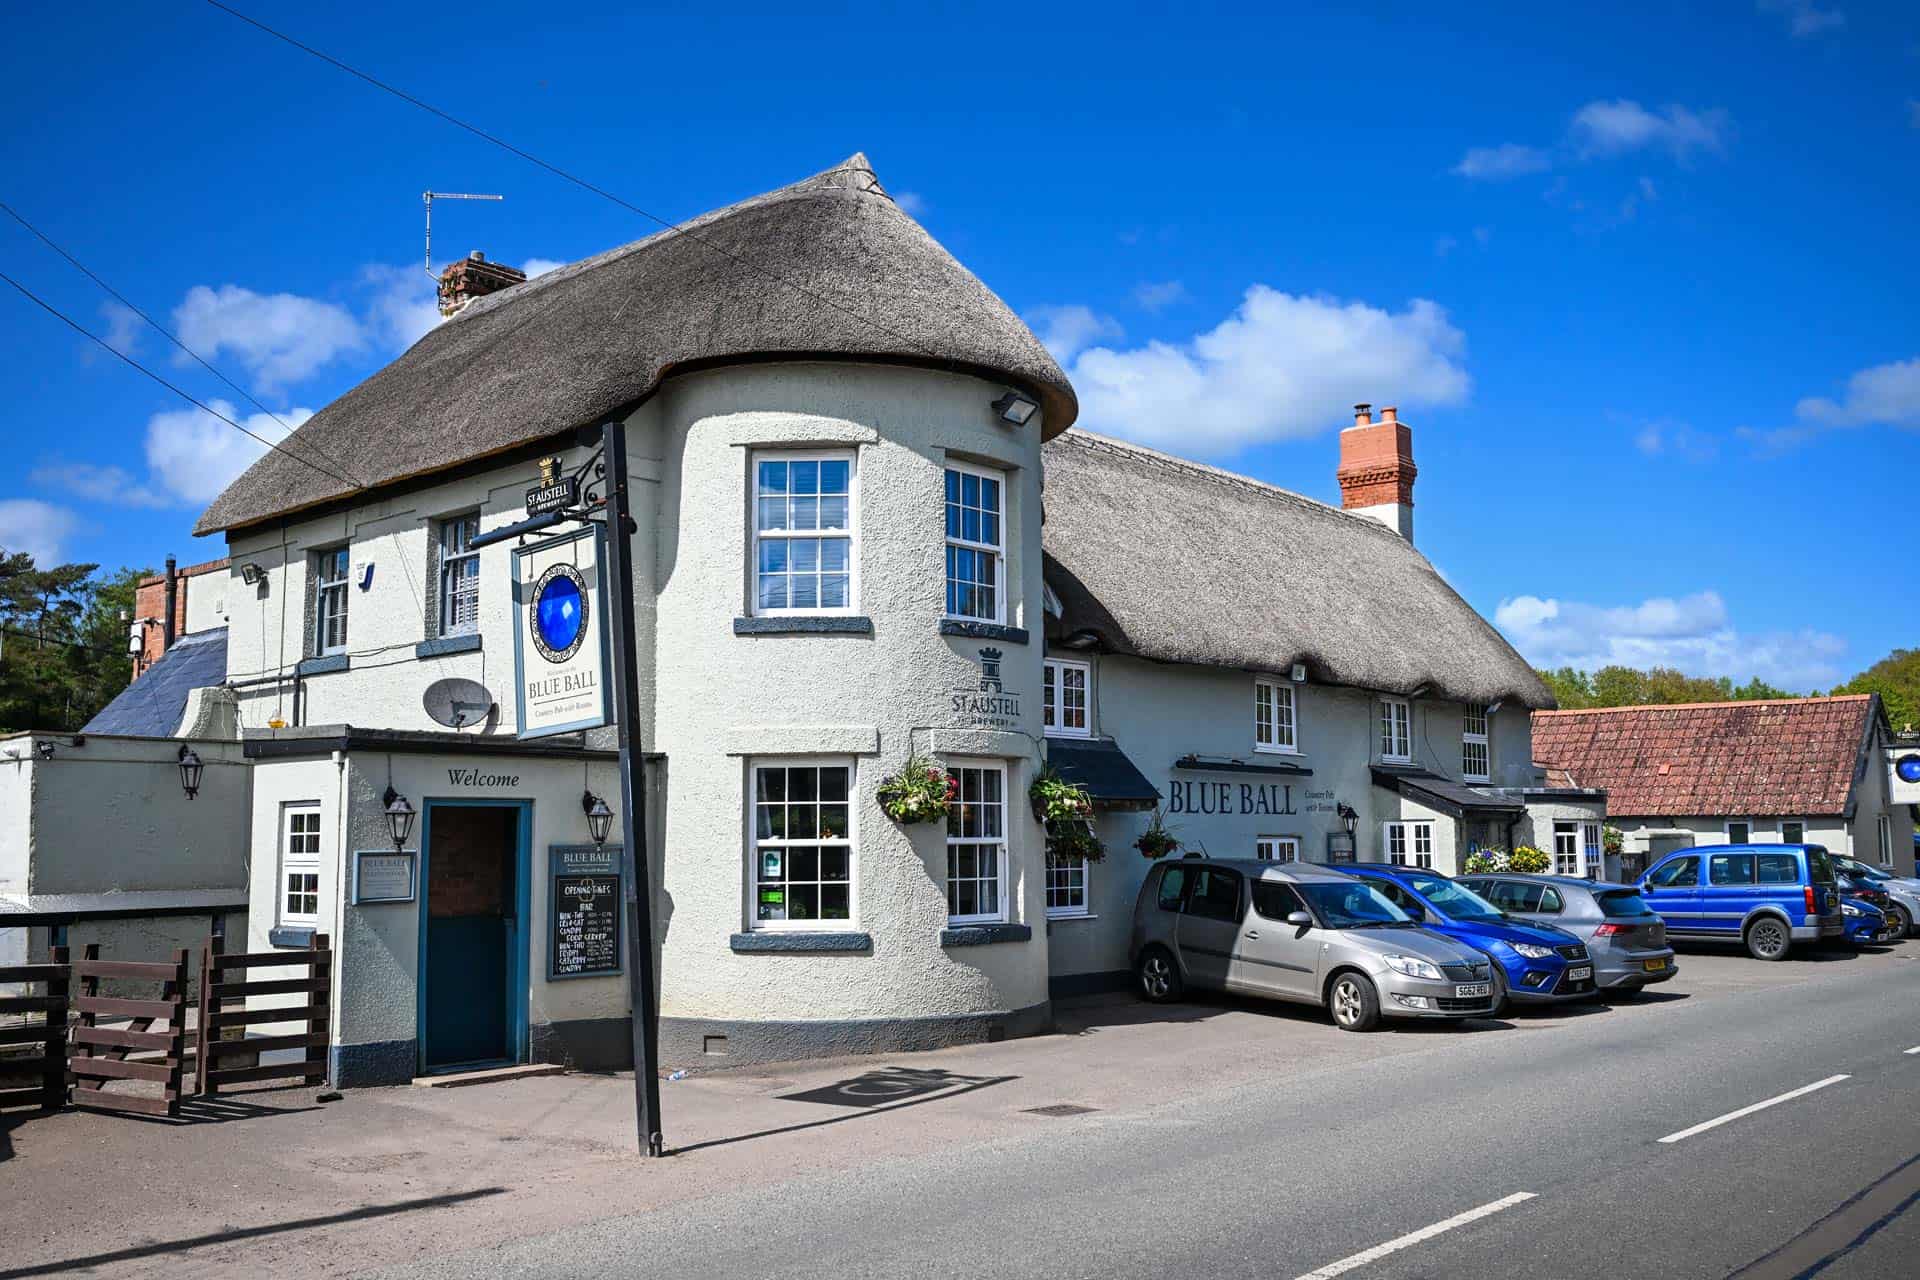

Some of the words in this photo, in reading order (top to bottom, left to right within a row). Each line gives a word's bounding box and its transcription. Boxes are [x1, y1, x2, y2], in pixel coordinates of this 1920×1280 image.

[536, 484, 568, 504] AUSTELL
[529, 678, 560, 699] BLUE
[564, 670, 598, 692] BALL
[969, 697, 1020, 716] AUSTELL
[448, 769, 519, 787] Welcome
[1169, 780, 1232, 814] BLUE
[1240, 783, 1297, 815] BALL
[564, 853, 587, 863] BLUE
[590, 853, 612, 863] BALL
